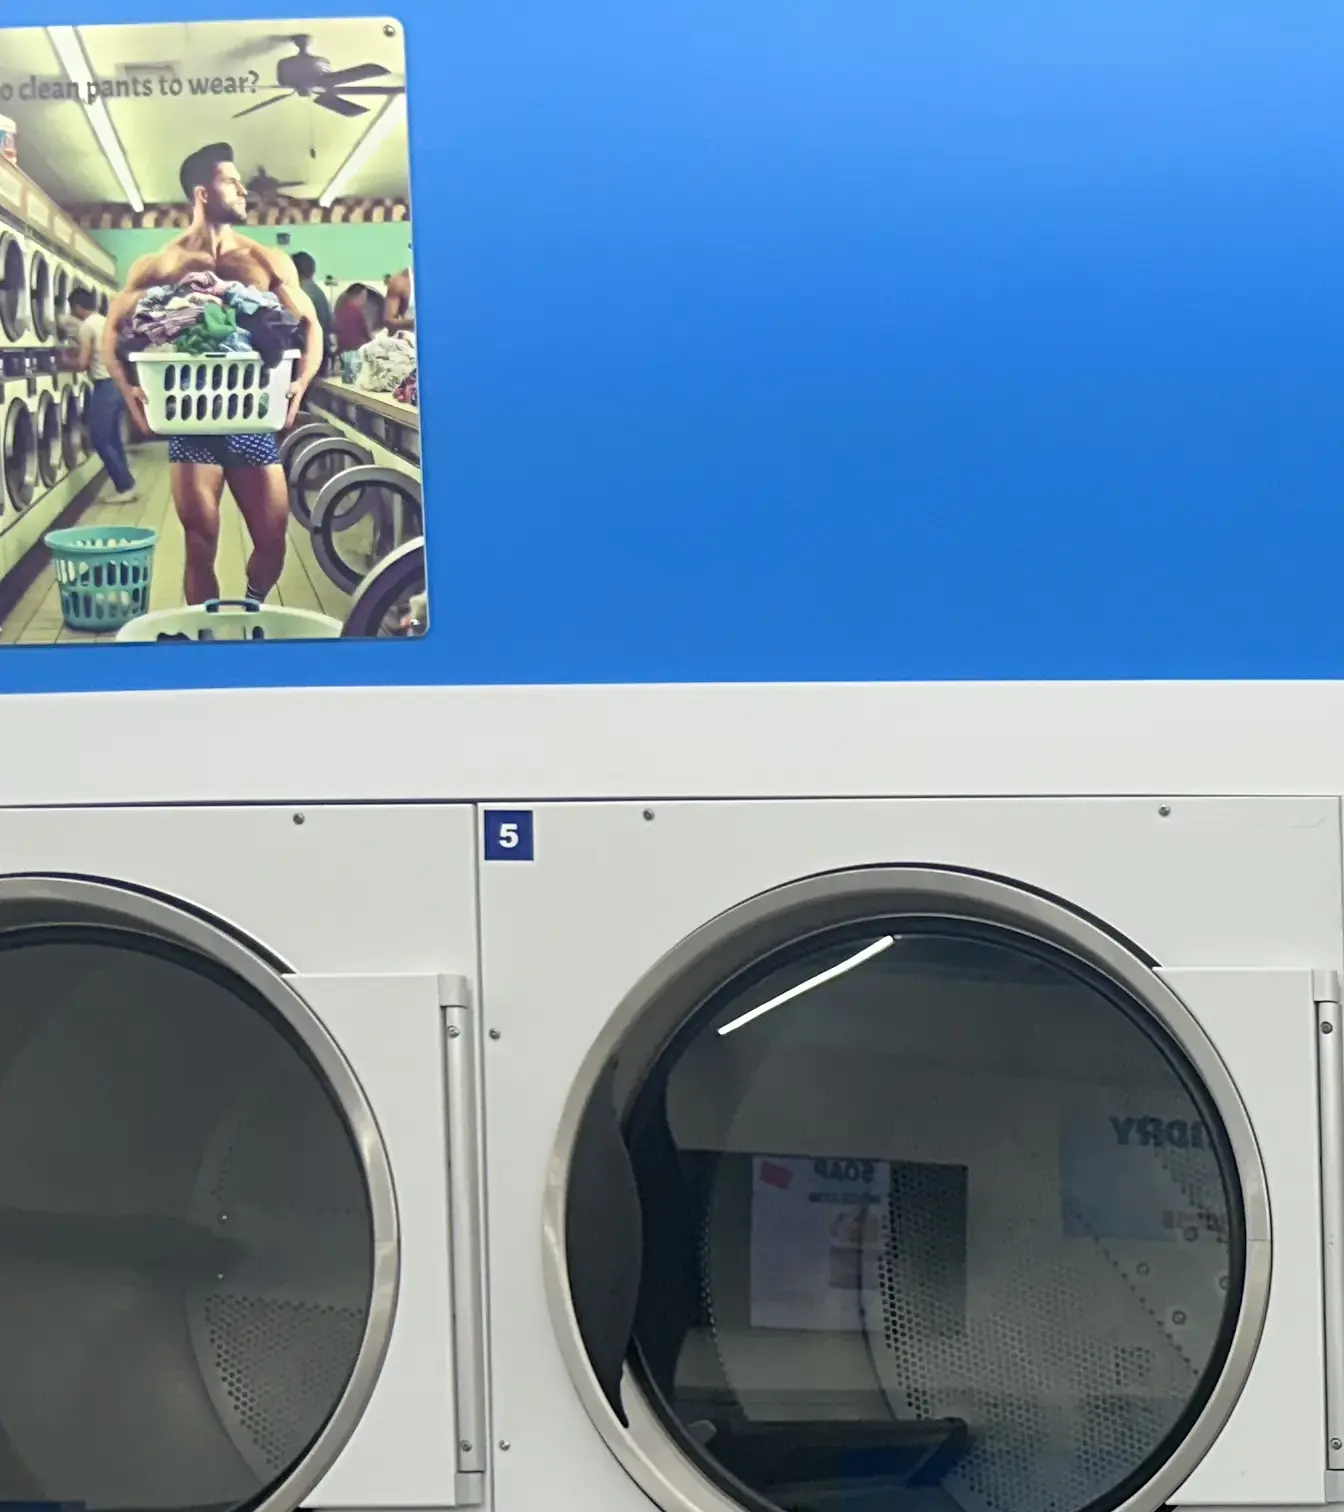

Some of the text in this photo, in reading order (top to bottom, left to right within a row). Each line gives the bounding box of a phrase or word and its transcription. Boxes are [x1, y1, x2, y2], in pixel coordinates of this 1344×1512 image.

[19, 75, 80, 100] clean
[86, 74, 153, 105] pants
[158, 75, 183, 97] to
[188, 69, 261, 96] wear?
[499, 823, 519, 848] 5
